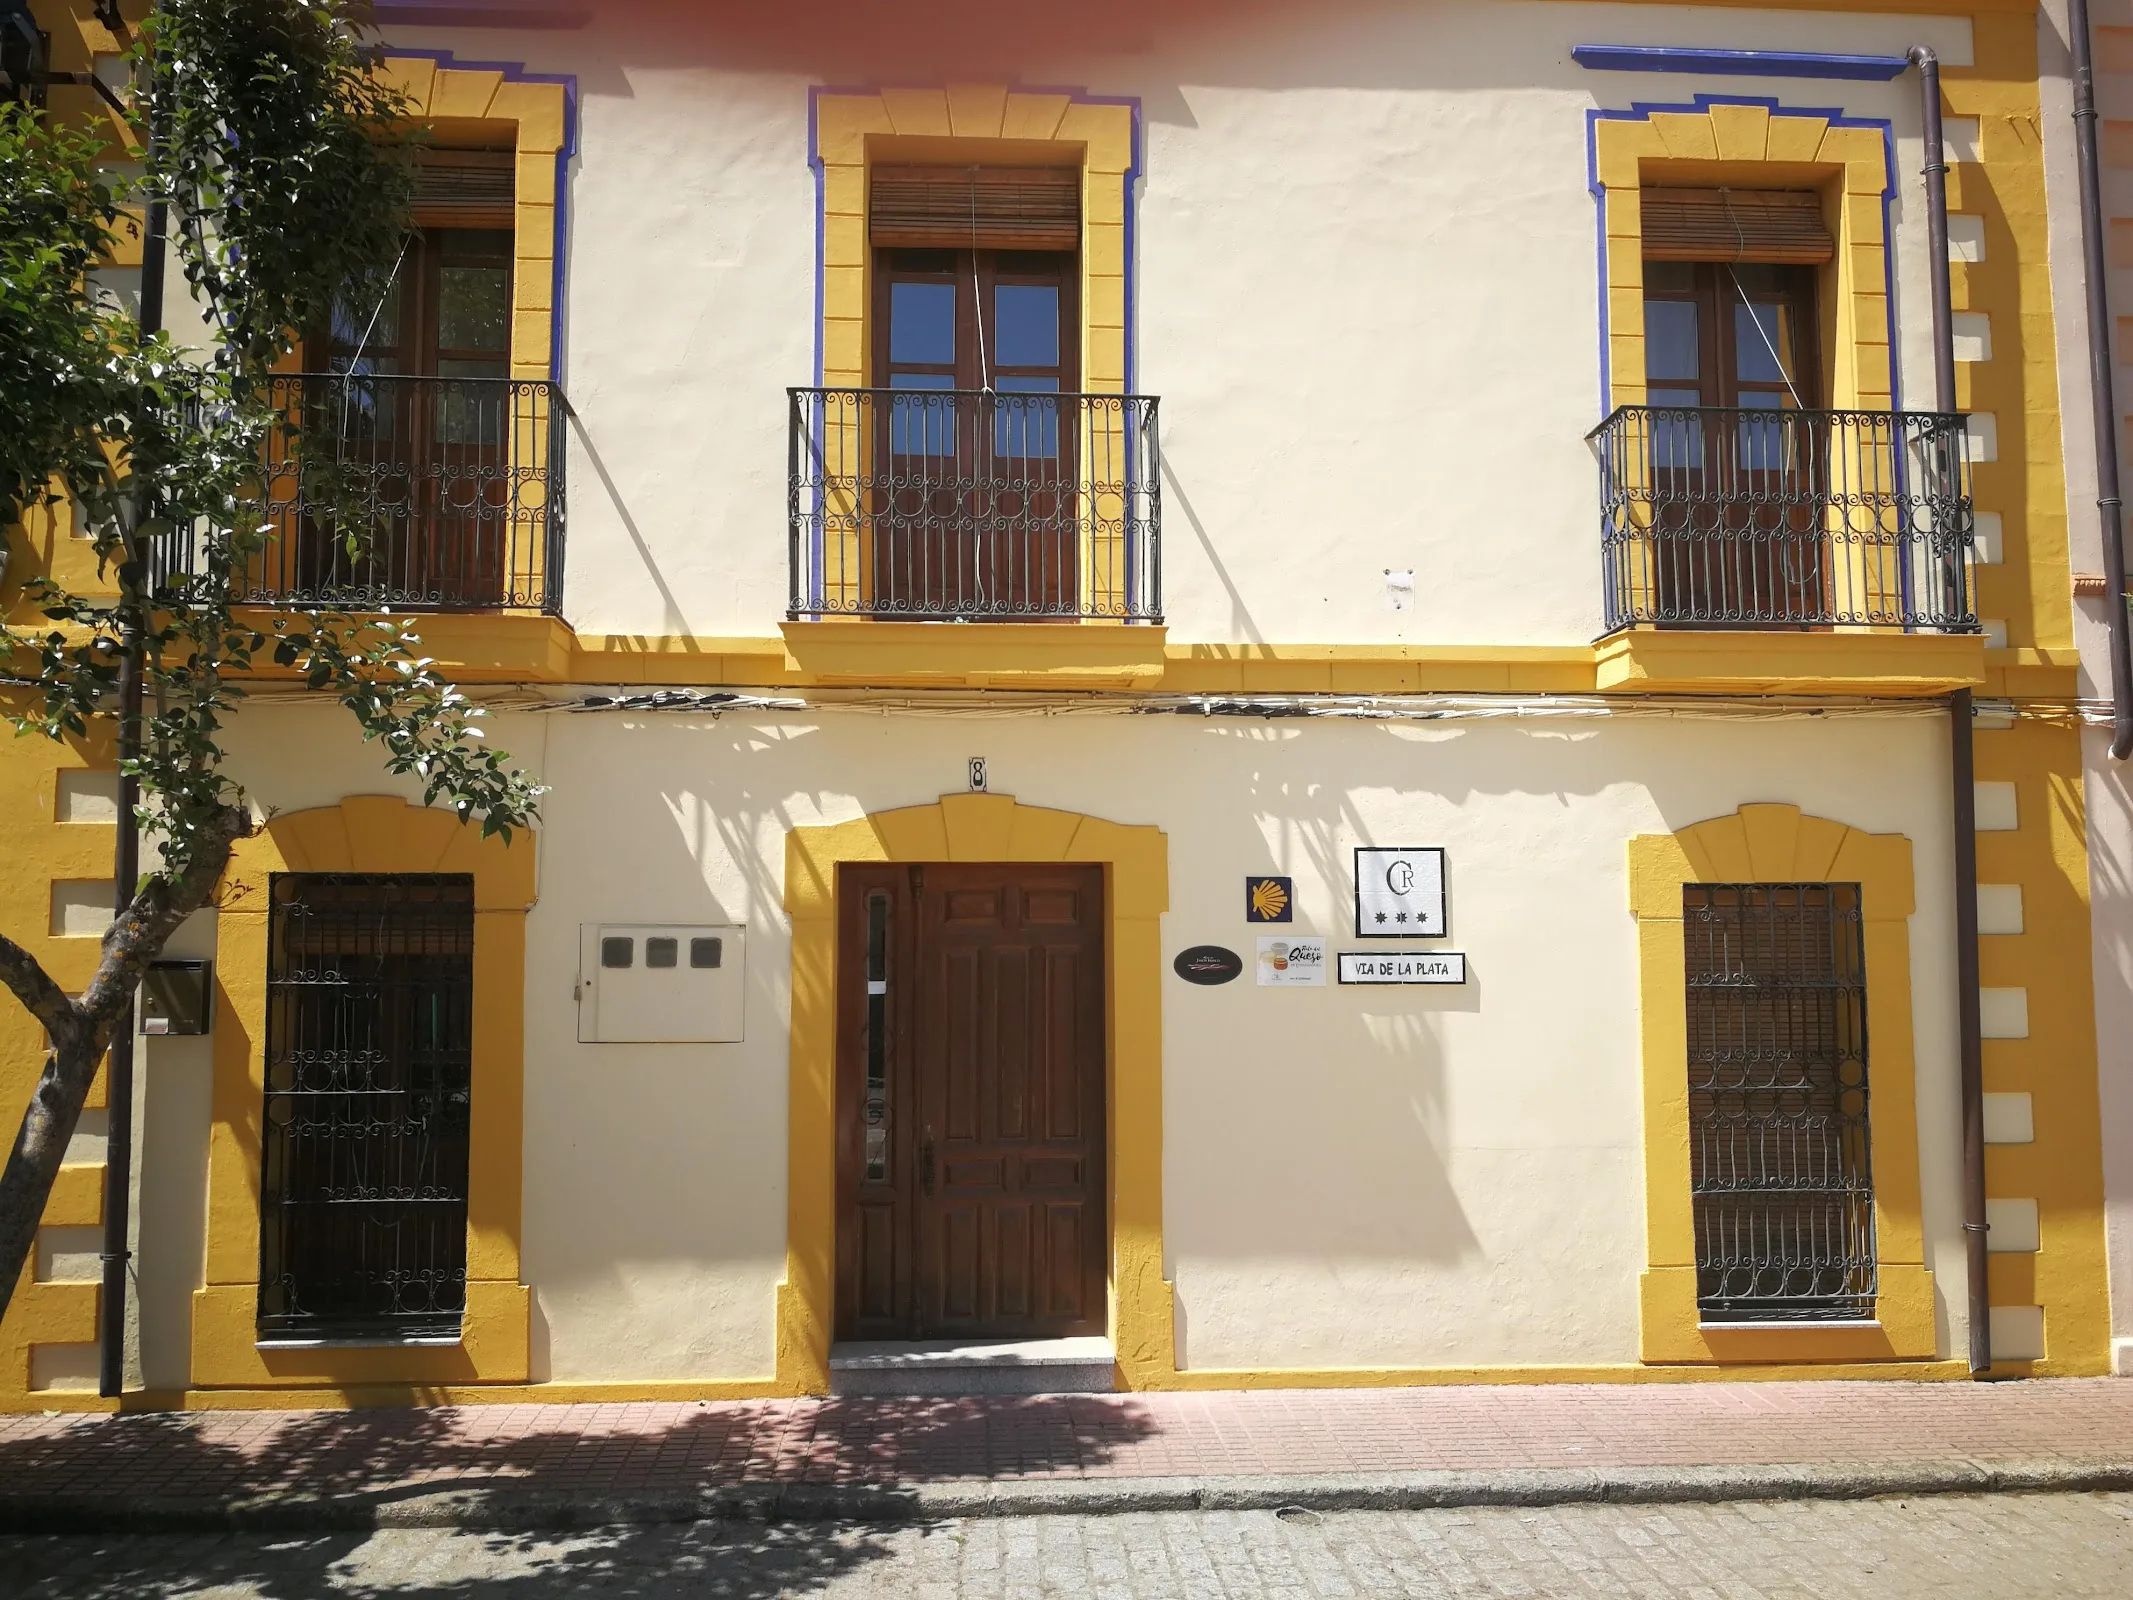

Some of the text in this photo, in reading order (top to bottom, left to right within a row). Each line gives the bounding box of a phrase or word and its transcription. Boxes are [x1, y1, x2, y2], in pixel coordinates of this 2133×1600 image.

[973, 761, 983, 787] 8
[1289, 947, 1324, 963] Queso
[1355, 962, 1449, 975] VIA DE LA PLATA
